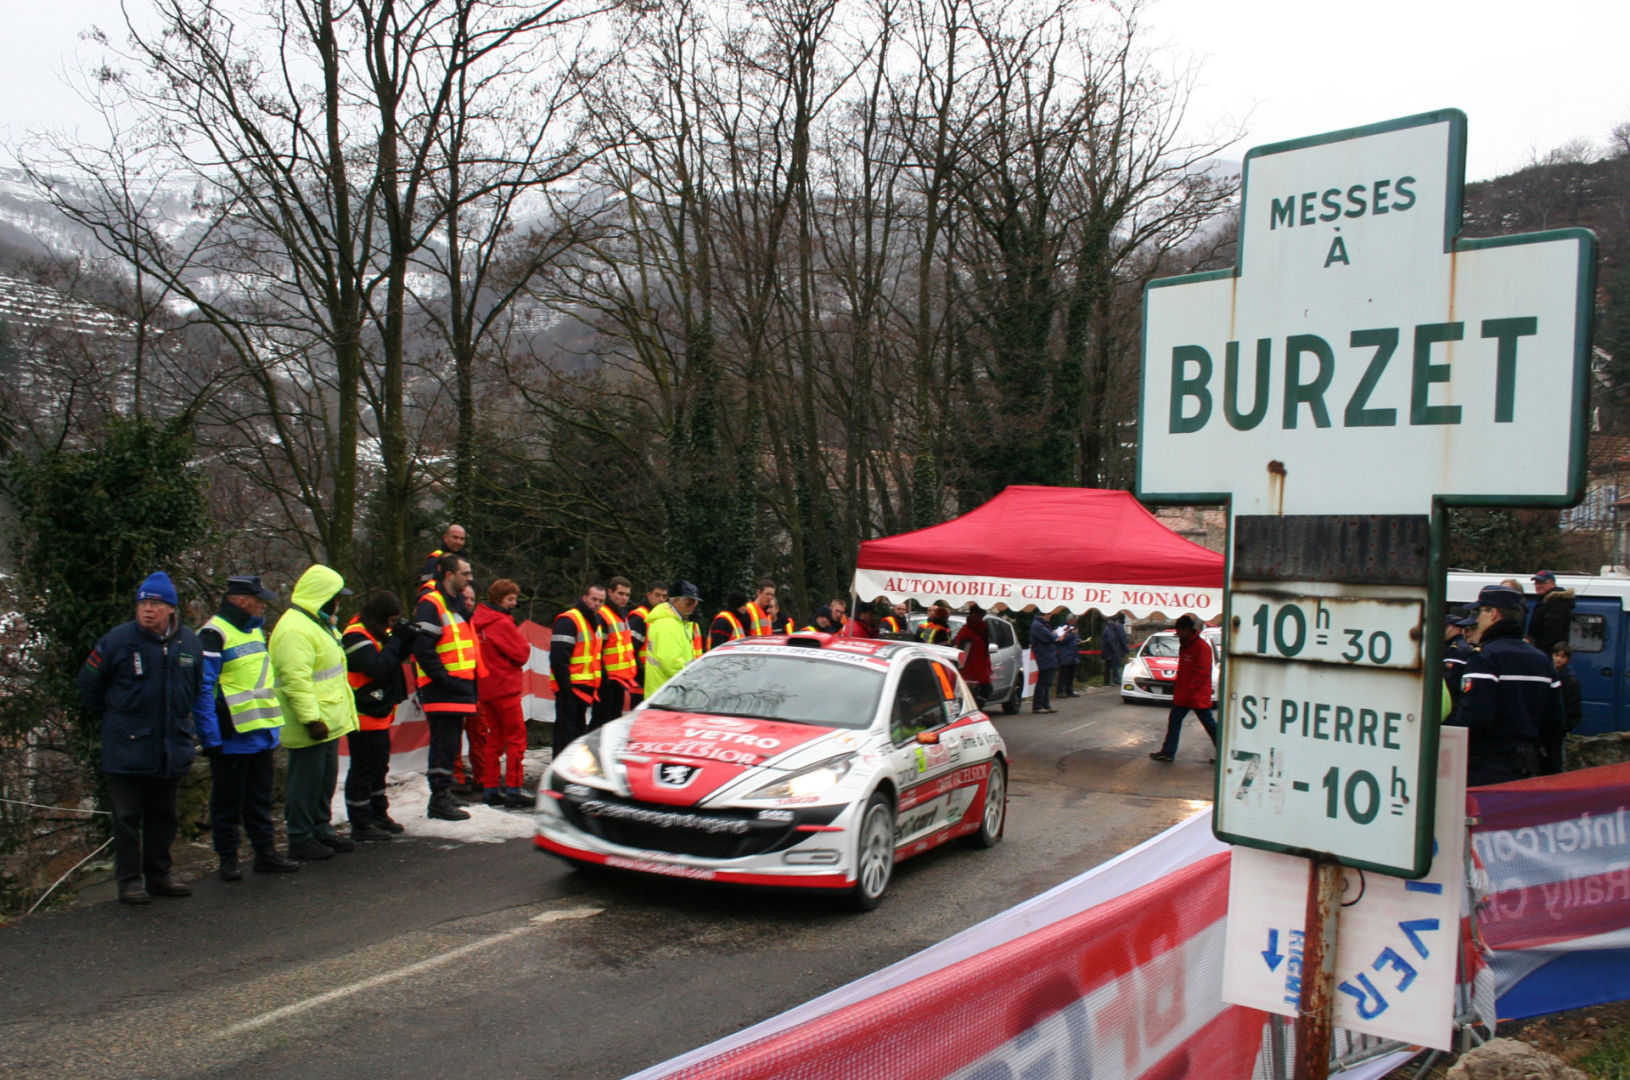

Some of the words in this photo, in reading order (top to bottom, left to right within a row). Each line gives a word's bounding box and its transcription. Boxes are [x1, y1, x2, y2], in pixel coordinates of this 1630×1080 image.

[1270, 175, 1417, 230] MESSES
[1324, 227, 1350, 268] À
[1168, 316, 1538, 434] BURZET
[885, 577, 1012, 599] AUTOMOBILE
[1021, 585, 1075, 601] CLUB
[1084, 588, 1112, 604] DE
[1122, 590, 1211, 609] MONACO
[1342, 628, 1392, 664] 30
[684, 728, 781, 749] VETRO
[1280, 699, 1402, 750] PIERRE
[629, 742, 757, 766] EXCELSIOR
